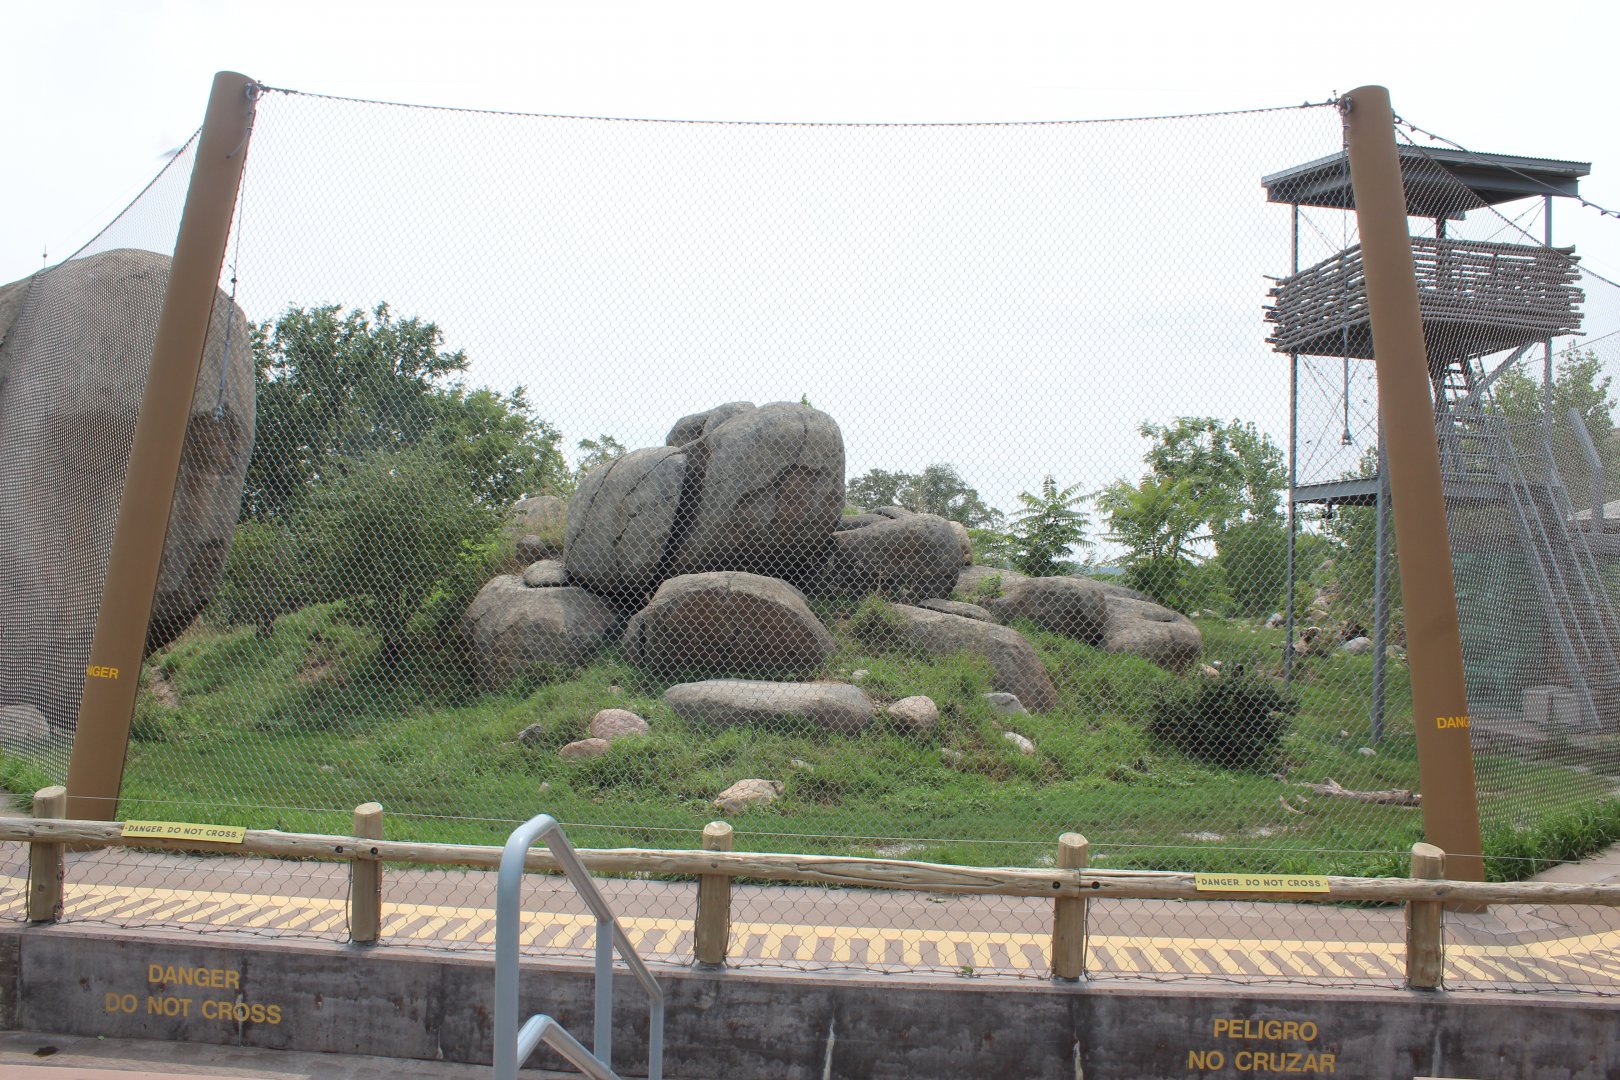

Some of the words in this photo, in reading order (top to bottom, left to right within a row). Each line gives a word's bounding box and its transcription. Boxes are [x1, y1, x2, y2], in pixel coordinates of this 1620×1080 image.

[167, 826, 181, 834] DO
[1264, 879, 1284, 887] NOT
[148, 964, 240, 989] DANGER
[105, 992, 138, 1014] DO
[147, 996, 192, 1017] NOT
[201, 1000, 282, 1024] CROSS
[1213, 1018, 1318, 1042] PELIGRO
[1188, 1050, 1224, 1071] NO
[1235, 1051, 1336, 1073] CRUZAR
